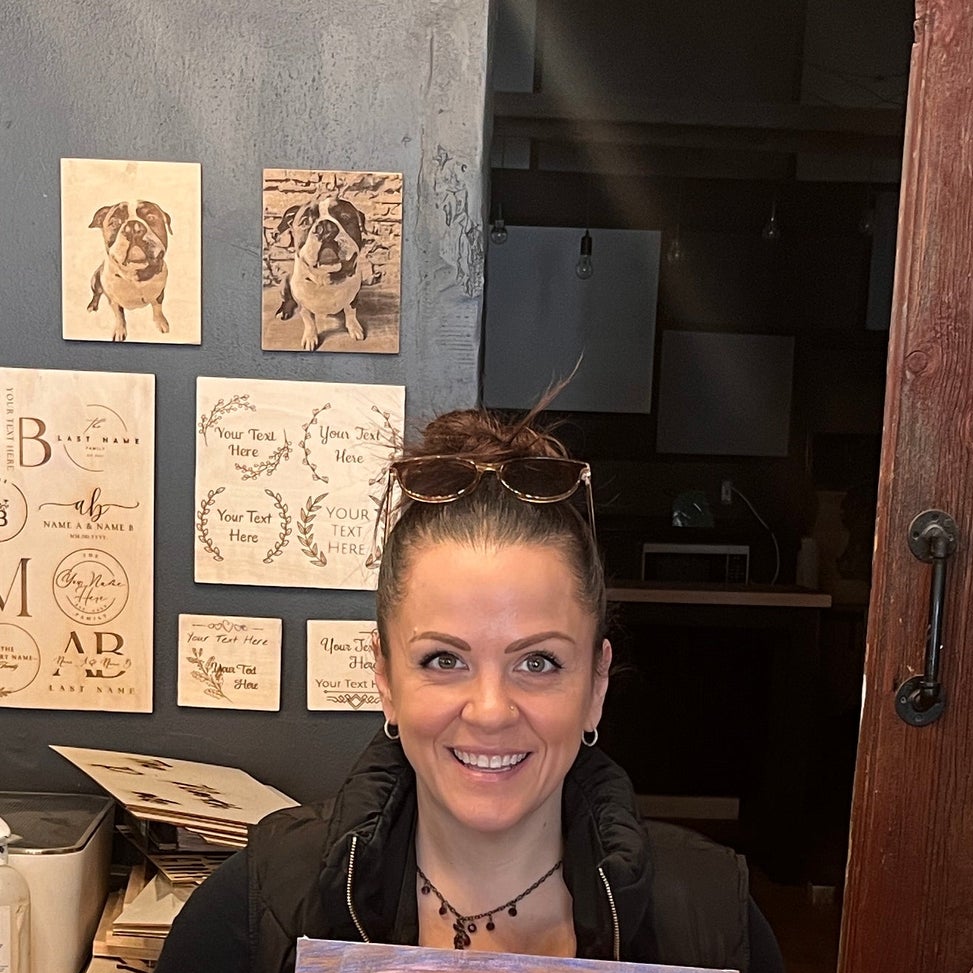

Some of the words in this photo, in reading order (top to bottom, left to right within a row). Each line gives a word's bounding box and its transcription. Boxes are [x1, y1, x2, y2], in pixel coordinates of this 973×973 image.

[6, 388, 14, 414] YOUR
[6, 419, 14, 442] TEXT
[214, 427, 242, 440] Your
[248, 429, 276, 442] Text
[319, 425, 349, 444] Your
[354, 426, 381, 441] Text
[19, 417, 52, 468] B
[228, 444, 259, 457] Here
[335, 449, 364, 463] Here
[6, 446, 14, 470] HERE
[217, 508, 243, 523] Your
[247, 511, 272, 523] Text
[326, 507, 370, 521] YOUR
[43, 521, 71, 529] NAME
[97, 523, 125, 531] NAME
[332, 524, 363, 538] TEXT
[229, 529, 259, 543] Here
[328, 541, 366, 555] HERE
[186, 632, 209, 644] Your
[216, 634, 238, 644] Text
[244, 635, 269, 646] Here
[320, 637, 351, 654] Your
[353, 639, 373, 652] Te
[49, 685, 85, 693] LAST
[97, 687, 136, 695] NAME
[315, 679, 341, 688] Your
[345, 679, 367, 688] Text
